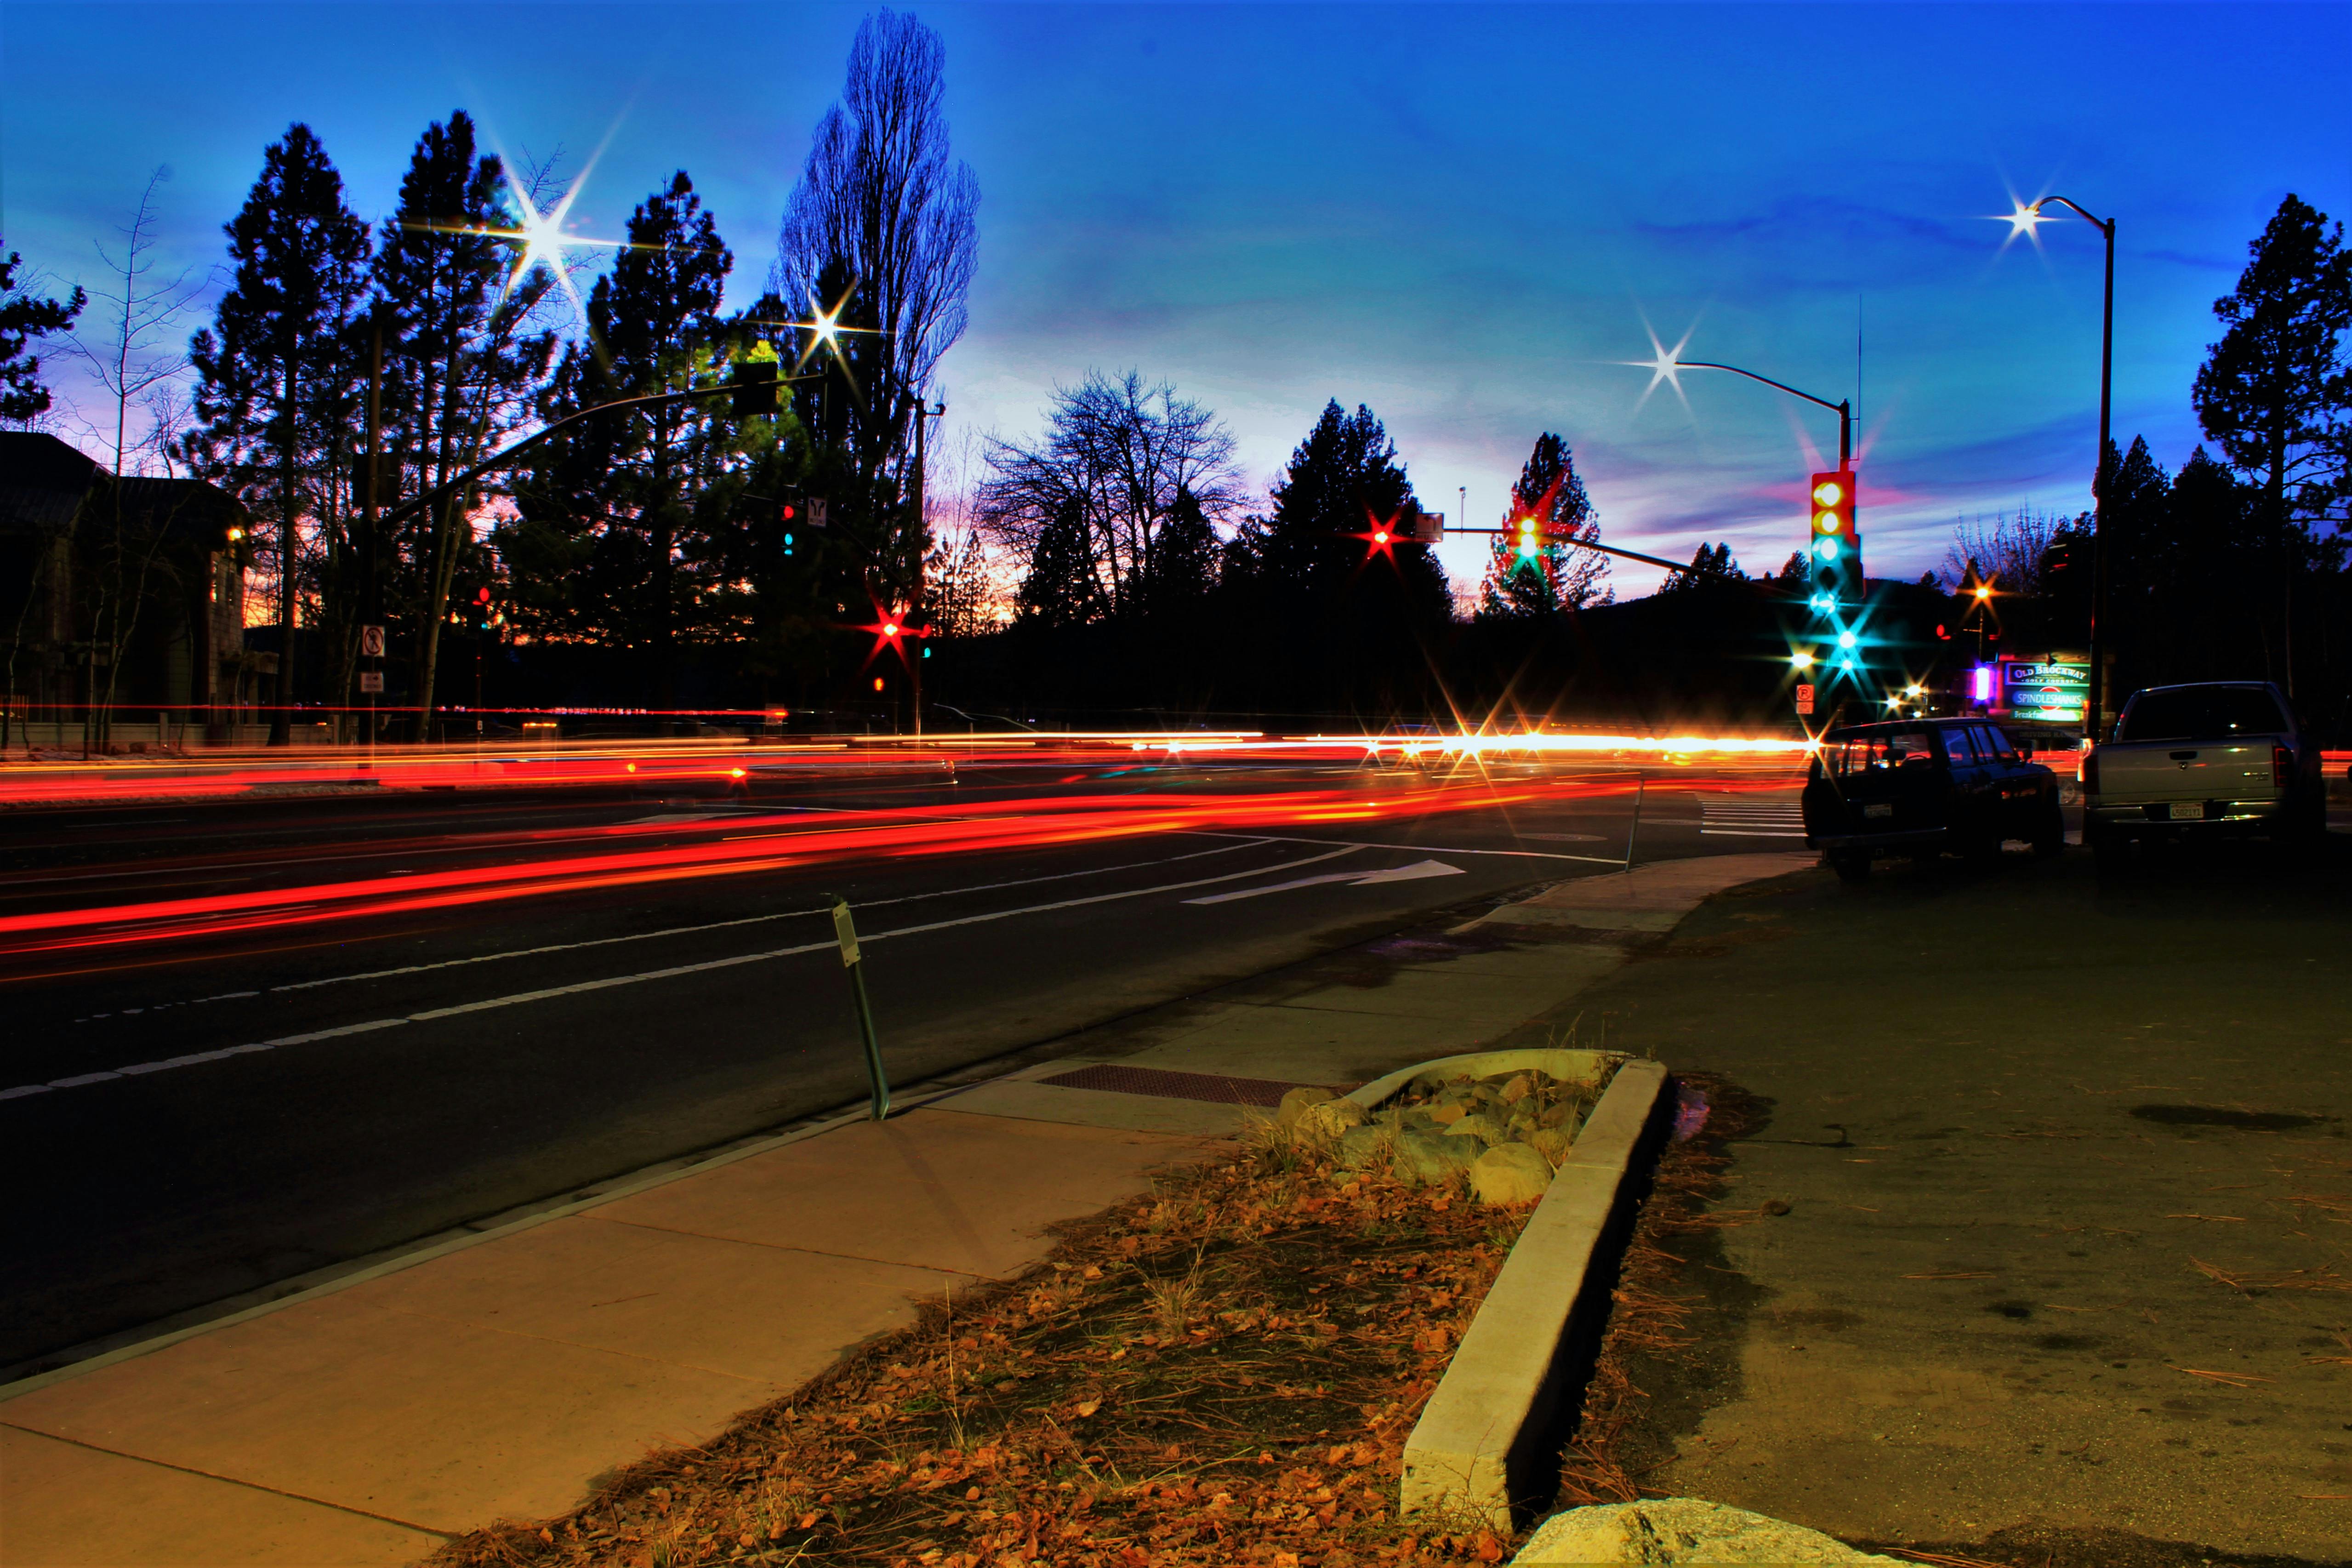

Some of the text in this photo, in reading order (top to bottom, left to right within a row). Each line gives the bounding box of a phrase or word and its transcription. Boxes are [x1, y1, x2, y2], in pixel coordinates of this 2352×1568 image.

[2014, 666, 2086, 679] OLD BROCKWAY
[2017, 693, 2082, 705] SPINDLESHANKS
[2014, 711, 2046, 719] Breakfa
